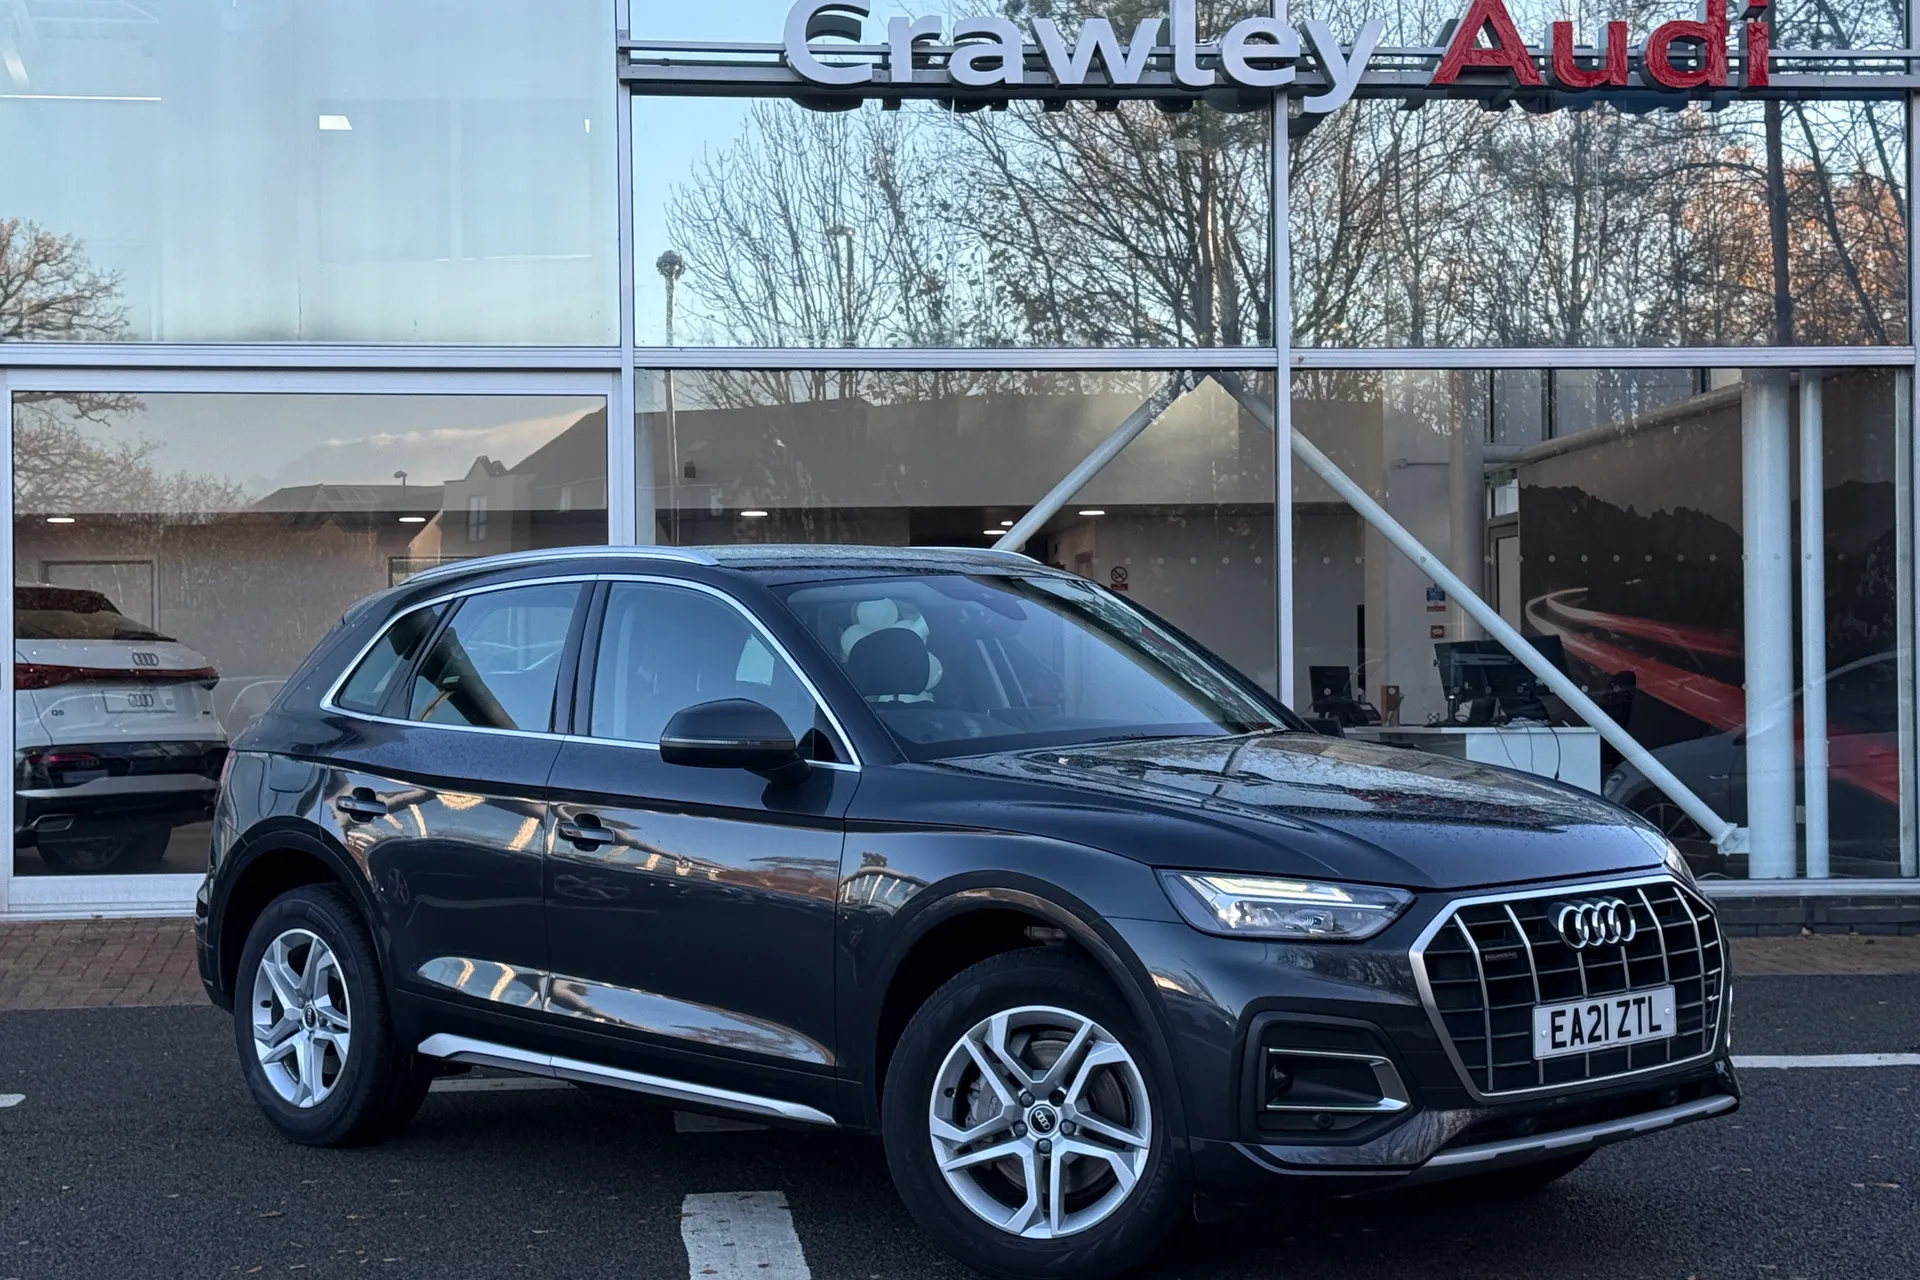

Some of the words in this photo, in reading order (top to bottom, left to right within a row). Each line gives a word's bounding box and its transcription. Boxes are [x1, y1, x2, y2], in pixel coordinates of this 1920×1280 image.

[783, 0, 1384, 113] Crawley
[1431, 0, 1769, 88] Audi
[1551, 1003, 1609, 1050] EA21
[1617, 996, 1662, 1038] ZTL
